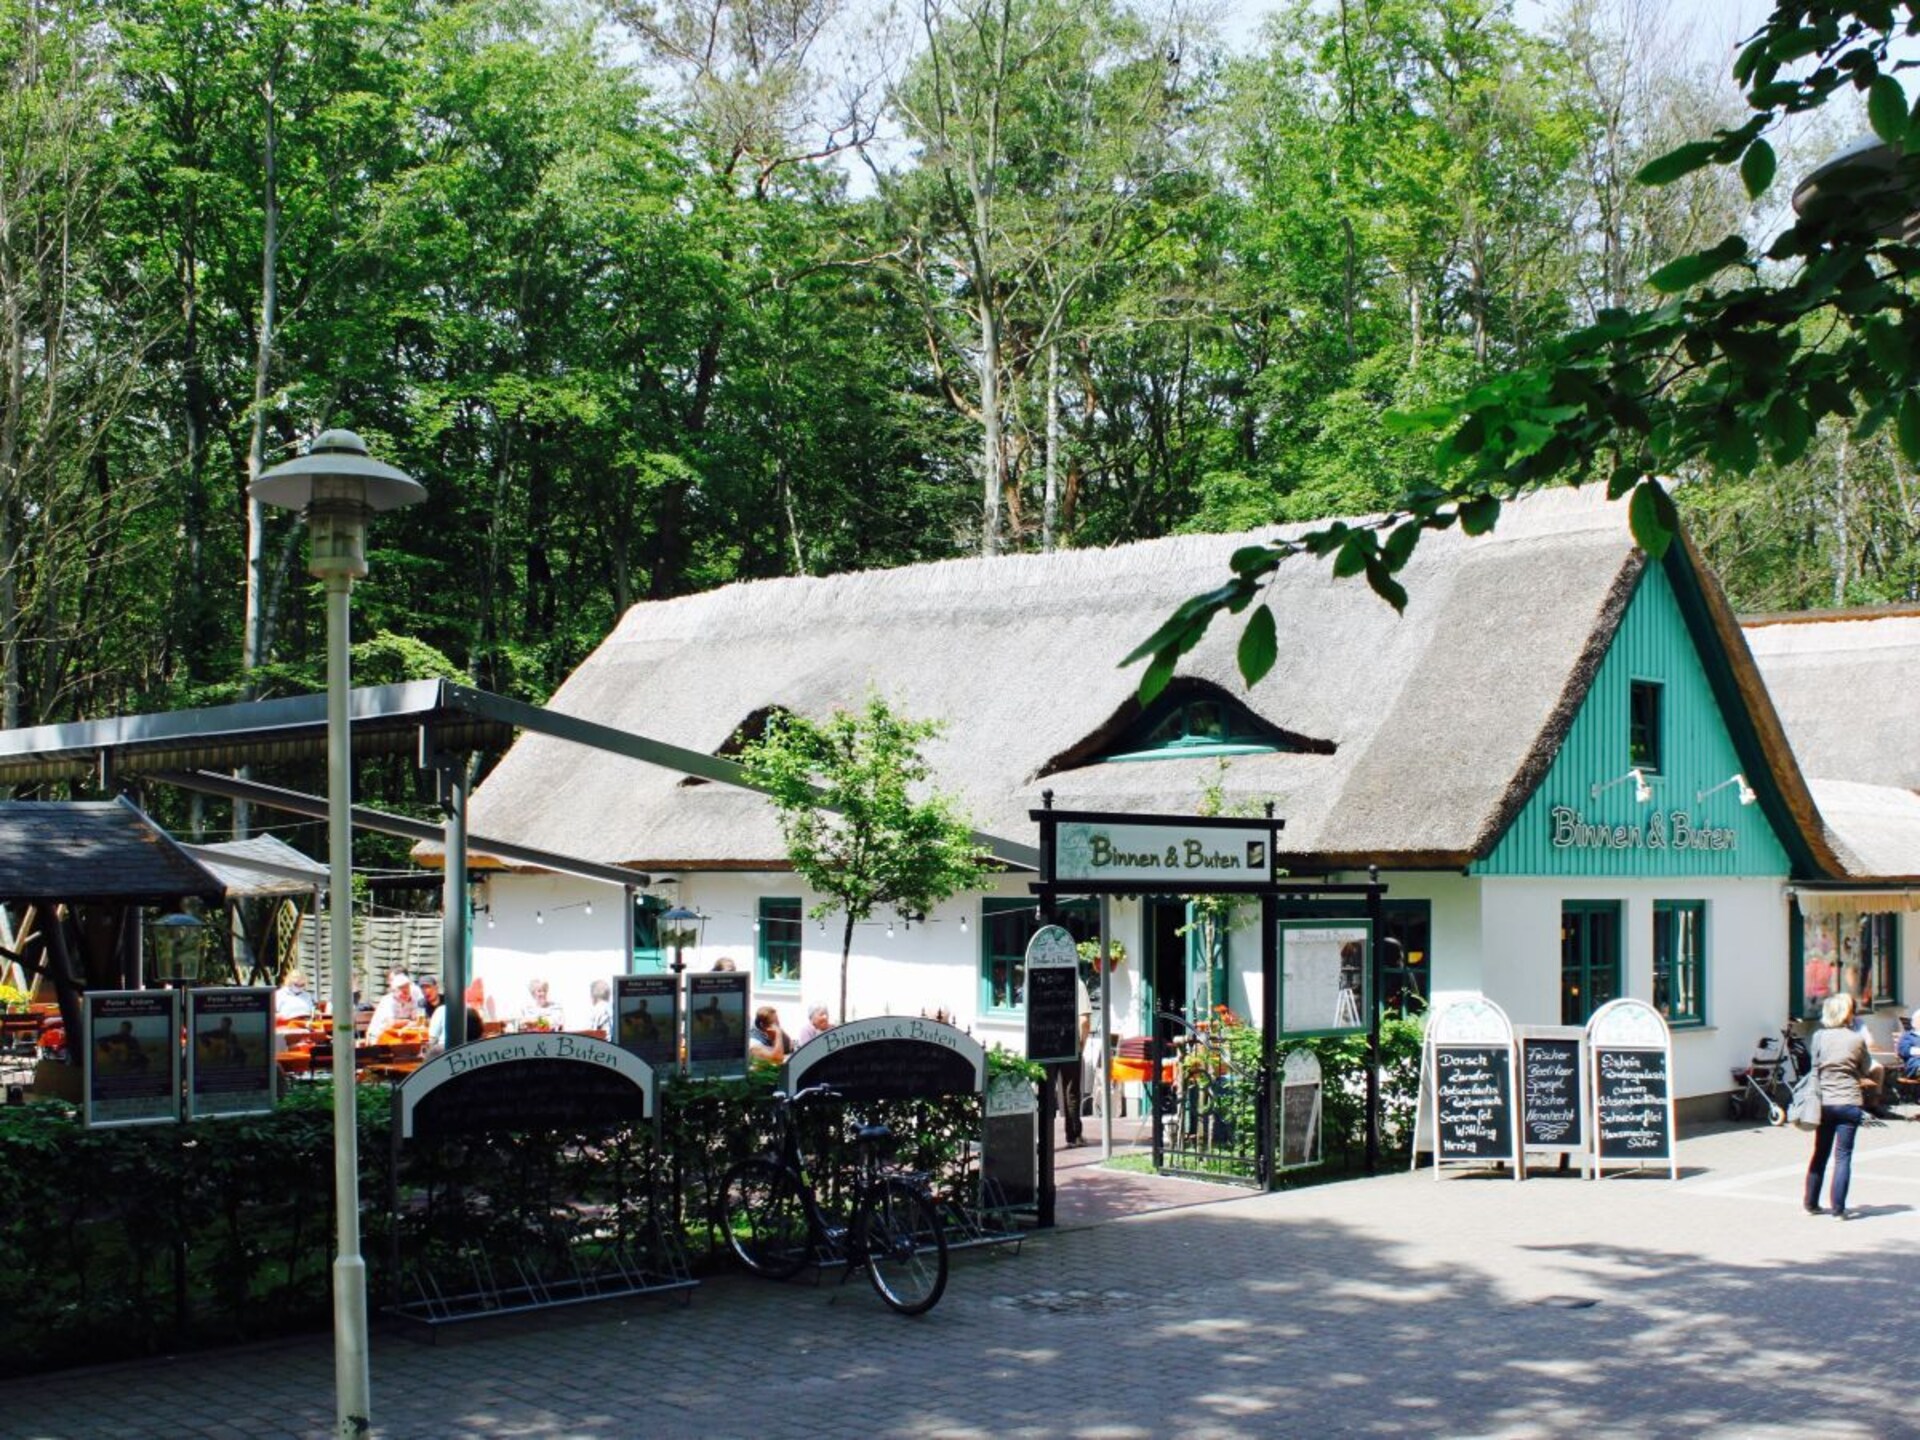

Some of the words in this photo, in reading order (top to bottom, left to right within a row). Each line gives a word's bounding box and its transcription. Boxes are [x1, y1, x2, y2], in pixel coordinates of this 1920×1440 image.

[1552, 805, 1642, 849] Binnen
[1646, 811, 1666, 849] &
[1671, 810, 1736, 850] Buten
[1089, 834, 1160, 867] Binnen
[1164, 845, 1179, 868] &
[1183, 838, 1240, 868] Buten
[824, 1027, 886, 1051] Binnen
[892, 1023, 903, 1037] &
[909, 1020, 957, 1048] Buten
[445, 1046, 526, 1076] Binnen
[534, 1041, 548, 1057] &
[556, 1036, 618, 1067] Buten
[1438, 1053, 1488, 1066] Dorsch
